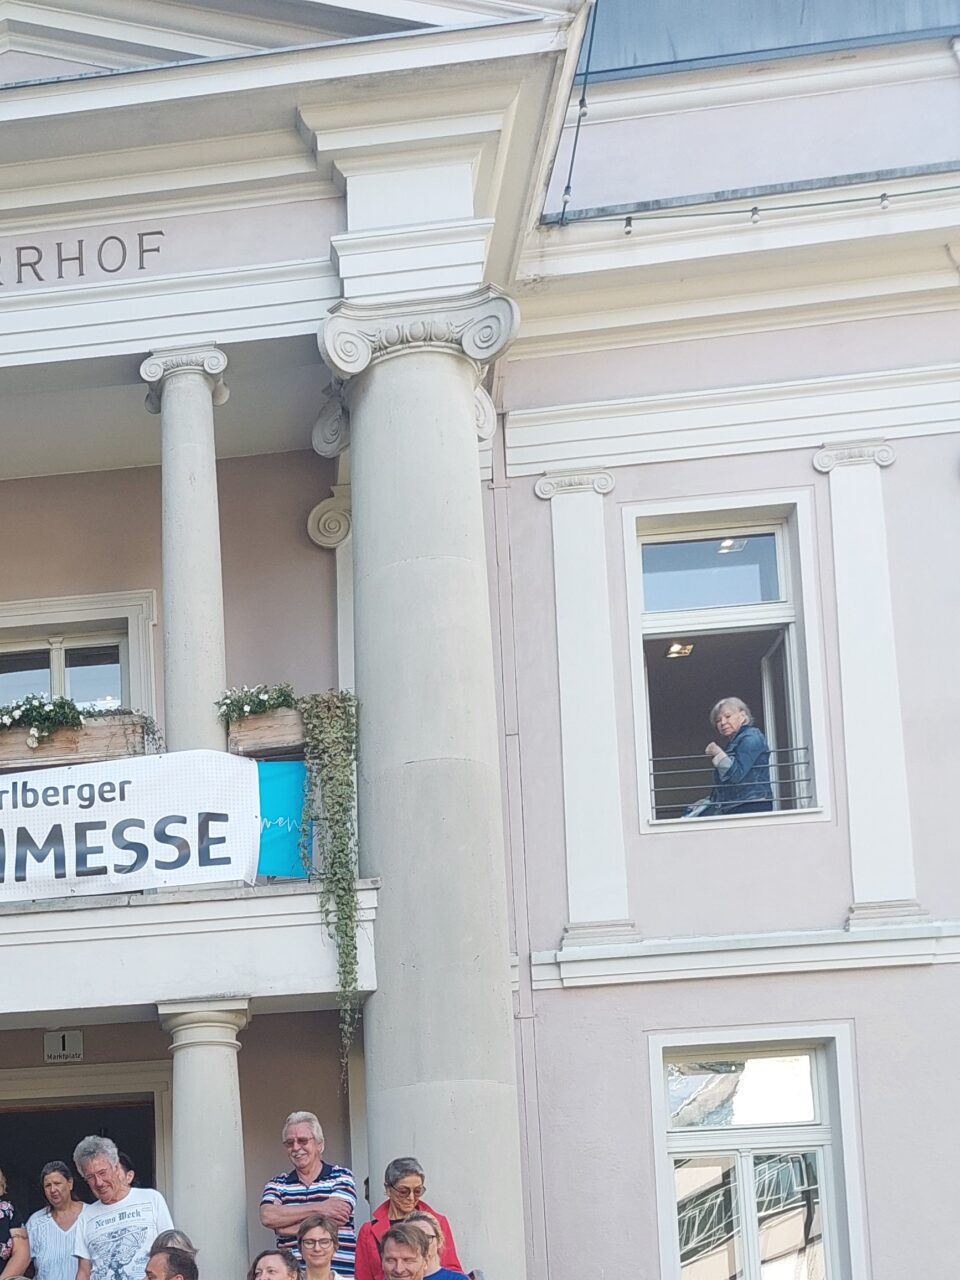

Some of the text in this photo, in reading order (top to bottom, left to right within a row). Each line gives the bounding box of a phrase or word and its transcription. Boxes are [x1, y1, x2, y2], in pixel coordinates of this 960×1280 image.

[61, 1033, 66, 1051] 1
[47, 1052, 81, 1060] Marktplatz
[118, 1209, 142, 1221] Week
